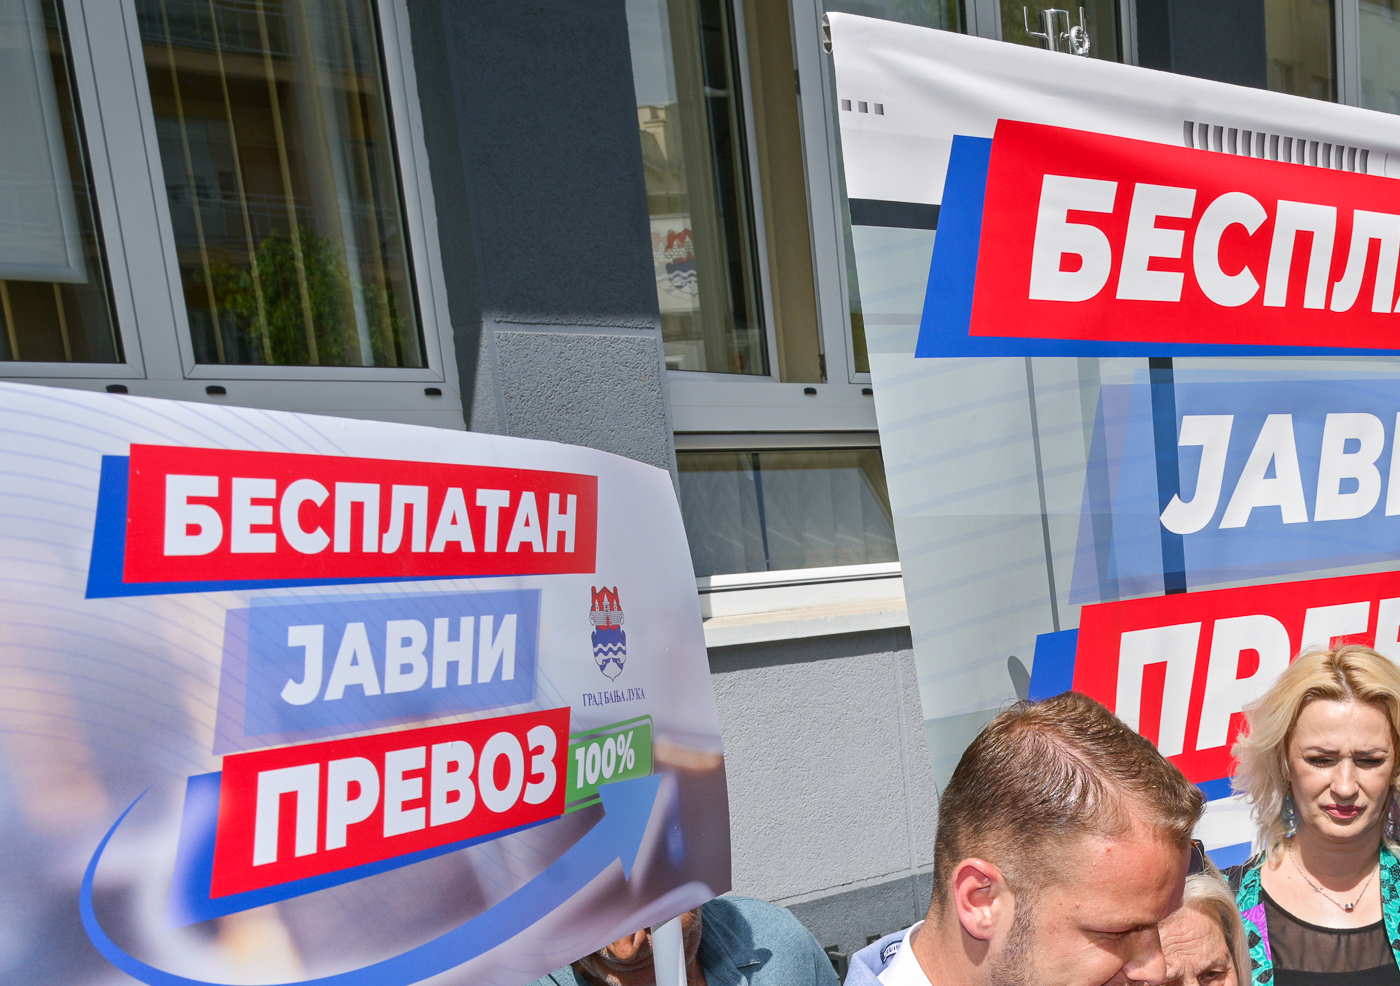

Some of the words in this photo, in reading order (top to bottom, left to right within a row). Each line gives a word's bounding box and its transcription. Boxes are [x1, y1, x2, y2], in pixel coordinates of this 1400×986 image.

[163, 473, 577, 557] БЕСПЛАТАН
[279, 614, 518, 707] ЈАВНИ
[582, 692, 604, 707] ГРАД
[604, 690, 626, 704] БАЊА
[626, 687, 646, 701] ЛУКА
[252, 724, 558, 867] ПРЕВОЗ
[575, 731, 635, 789] 100%
